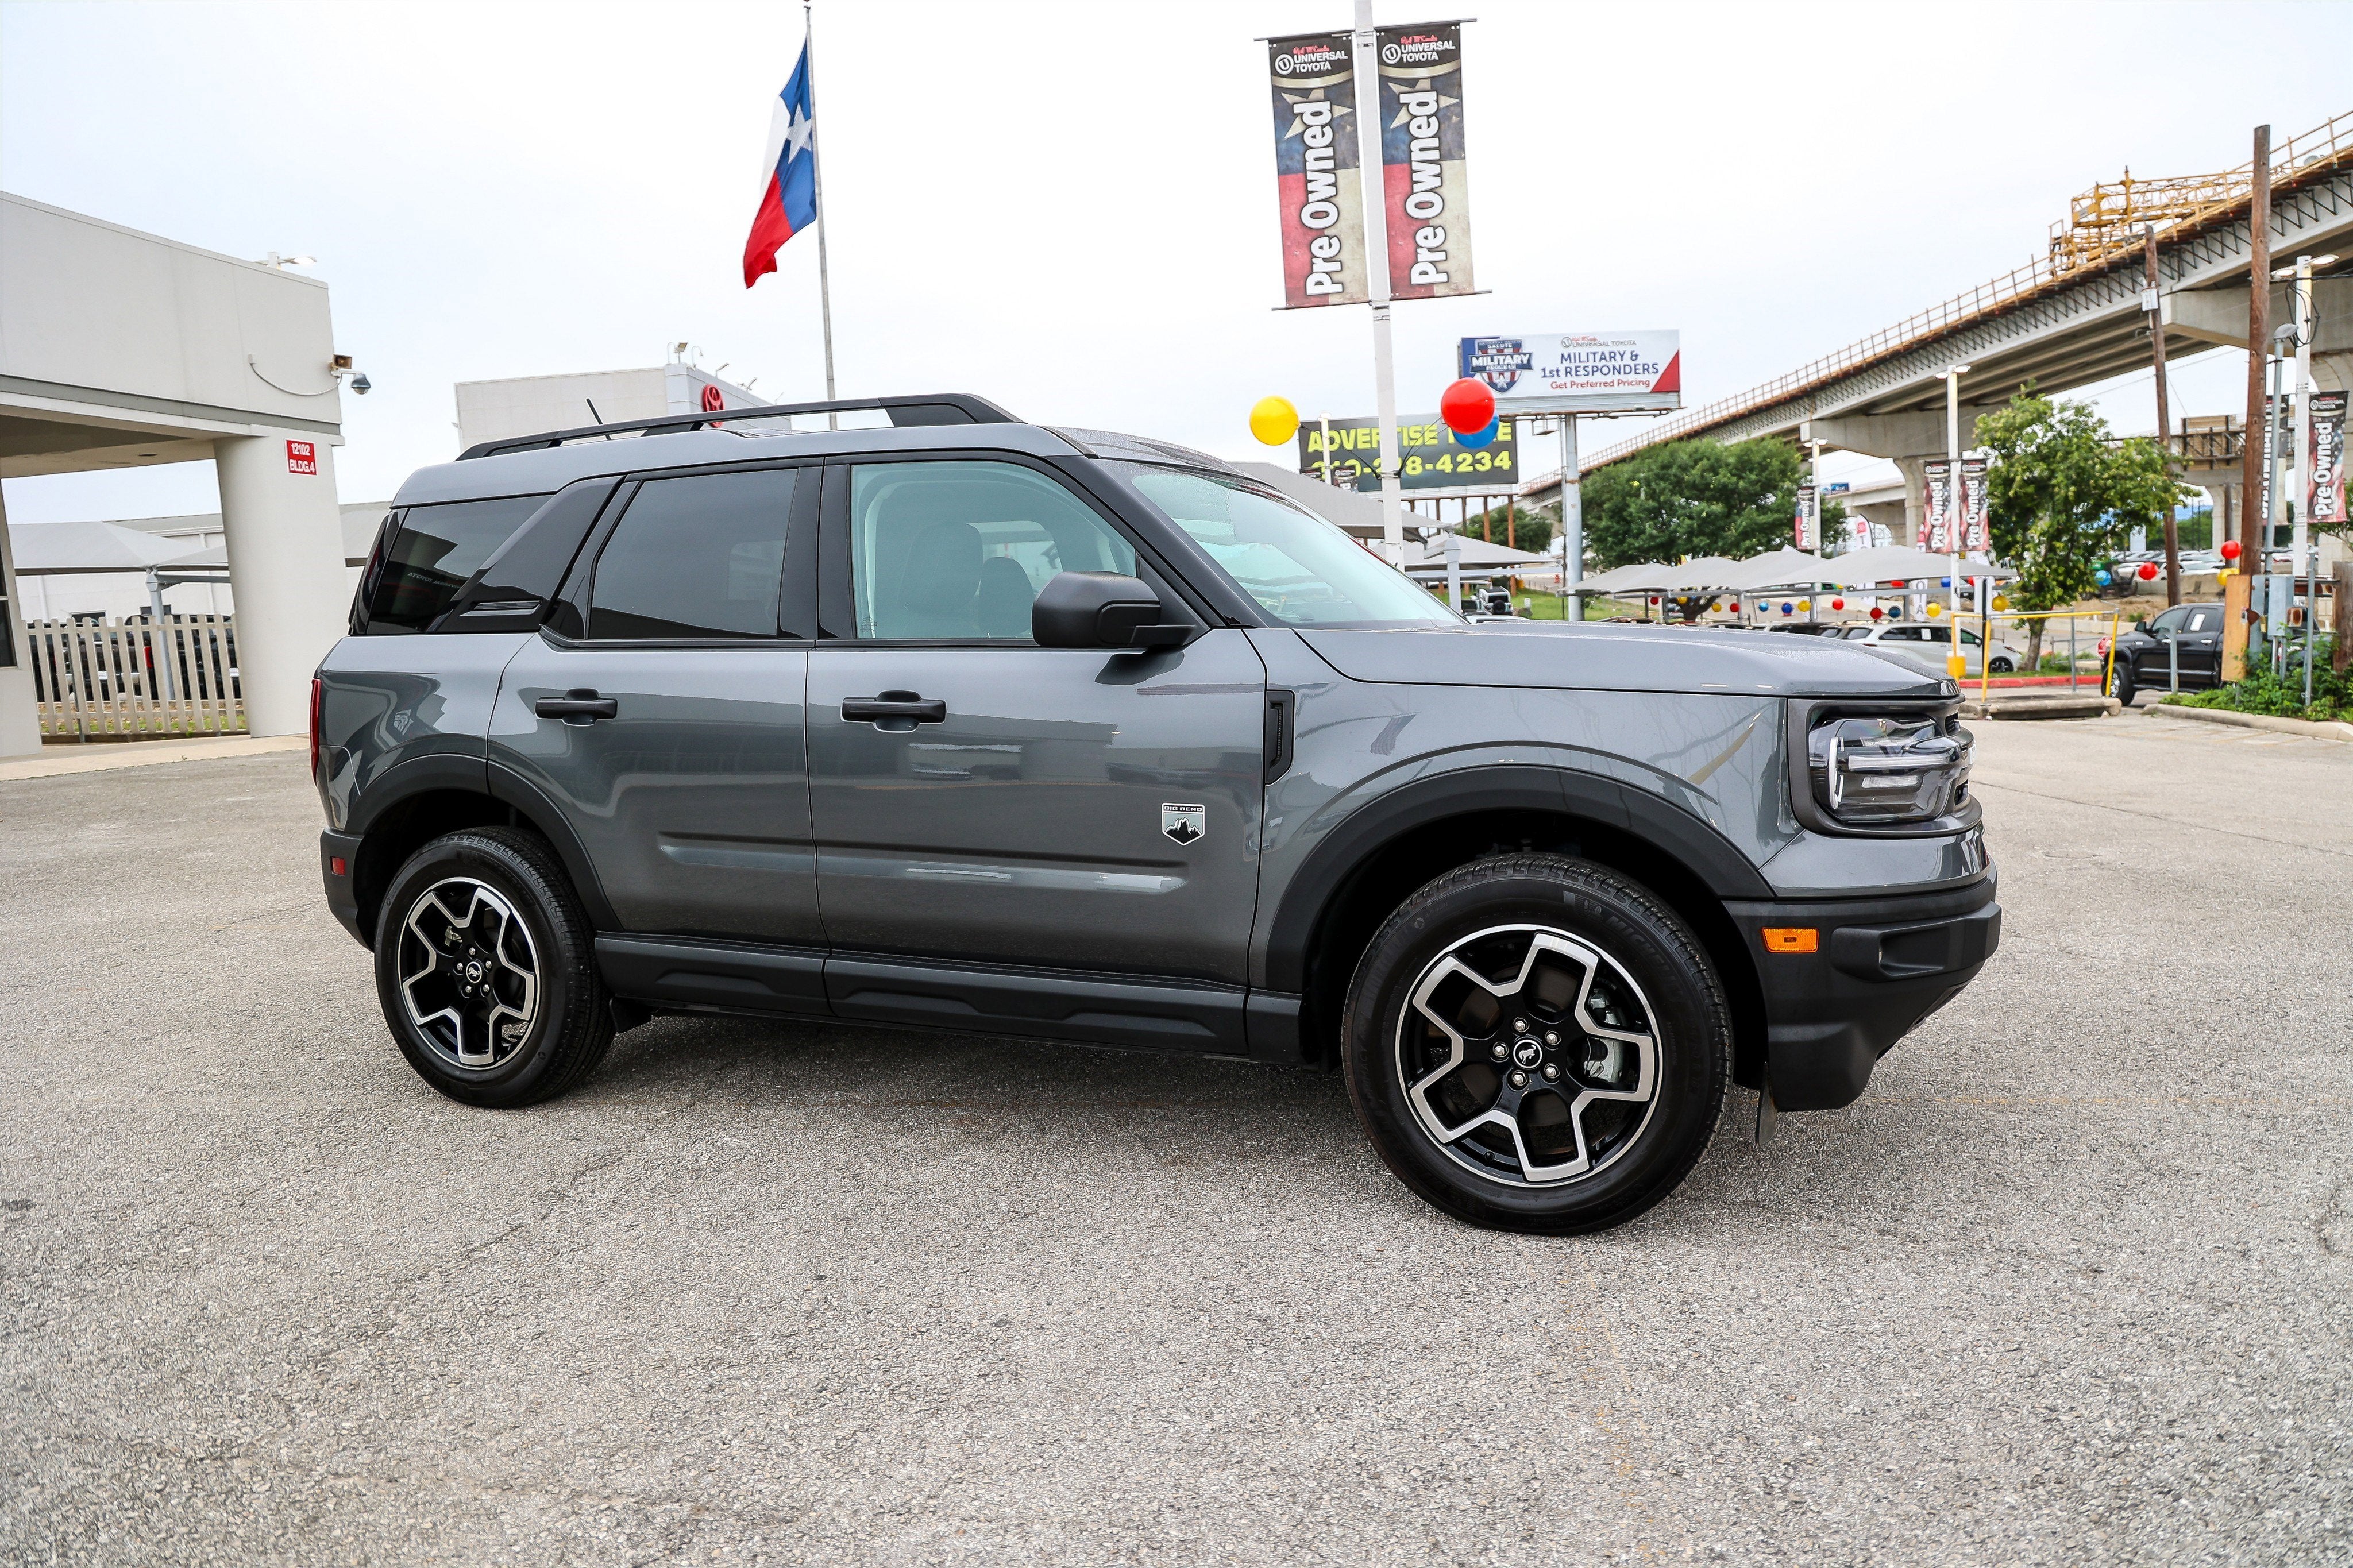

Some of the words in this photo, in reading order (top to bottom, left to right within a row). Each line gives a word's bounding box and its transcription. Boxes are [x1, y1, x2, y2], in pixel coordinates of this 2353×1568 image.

[1294, 50, 1348, 64] UNIVERSAL
[1402, 40, 1456, 53] UNIVERSAL
[1402, 51, 1439, 63] TOYOTA
[1294, 61, 1332, 73] TOYOTA
[1293, 101, 1339, 229] Owned
[1399, 91, 1444, 219] Owned
[1306, 235, 1343, 296] Pre
[1410, 226, 1449, 285] Pre
[1472, 354, 1529, 367] MILITARY
[1560, 350, 1627, 364] MILITARY
[1630, 349, 1640, 361] &
[1541, 367, 1561, 378] 1st
[1565, 362, 1660, 377] RESPONDERS
[1551, 380, 1567, 389] Get
[1570, 379, 1614, 389] Preferred
[1617, 378, 1650, 388] Pricing
[291, 442, 311, 456] 12102
[1307, 424, 1438, 453] ADVERISE
[2314, 422, 2333, 483] Owned
[1930, 481, 1943, 526] Owned
[1965, 480, 1980, 524] Owned
[2314, 486, 2333, 516] Pre
[1799, 500, 1810, 531] Owned
[1931, 526, 1945, 548] Pre
[1966, 526, 1981, 546] Pre
